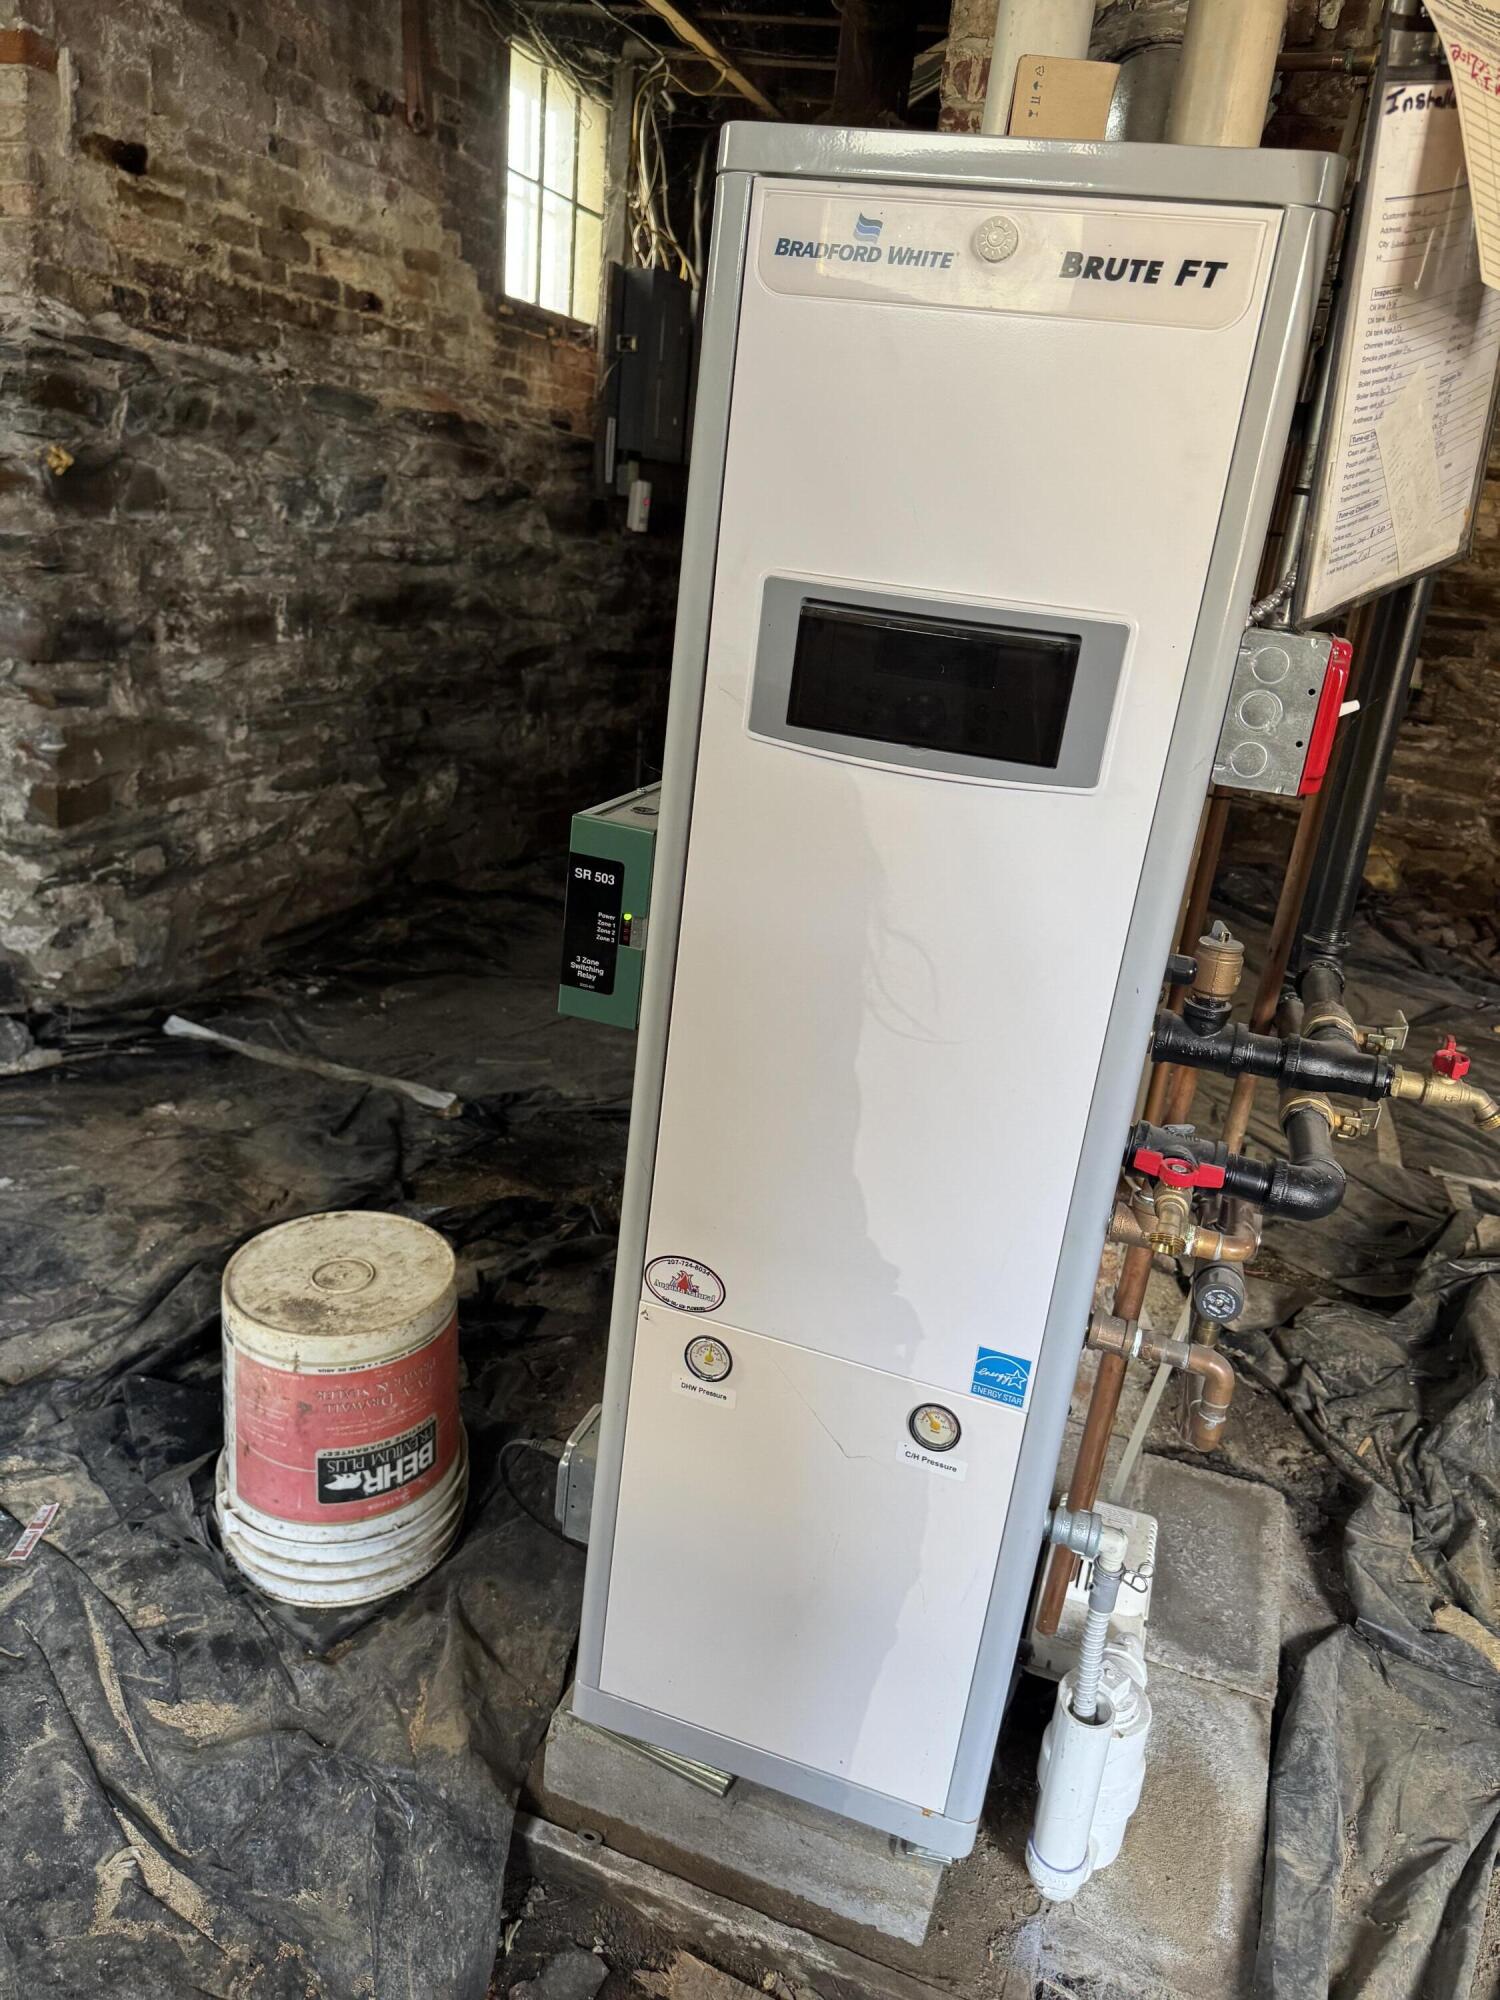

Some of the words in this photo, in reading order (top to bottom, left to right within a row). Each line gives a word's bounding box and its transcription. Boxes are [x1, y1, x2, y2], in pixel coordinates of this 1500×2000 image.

[774, 237, 882, 263] BRADFORD
[1059, 251, 1163, 285] BRUTE
[1174, 259, 1228, 289] FT
[574, 867, 592, 881] SR
[594, 871, 615, 886] 503
[597, 911, 616, 920] Power
[597, 919, 611, 928] Zone
[596, 926, 611, 935] Zone
[596, 934, 611, 942] Zone
[570, 961, 604, 976] Switching
[576, 955, 581, 963] 3
[581, 956, 600, 967] Zone
[577, 970, 597, 982] Relay
[681, 1382, 698, 1393] DHW
[698, 1387, 727, 1401] Pressure
[972, 1384, 1002, 1401] ENERGY
[1002, 1393, 1023, 1406] STAR
[371, 1426, 434, 1463] PREMIUM
[327, 1454, 365, 1473] PLUS
[362, 1440, 433, 1495] BEHR
[904, 1450, 920, 1461] C/H
[921, 1455, 957, 1474] Pressure
